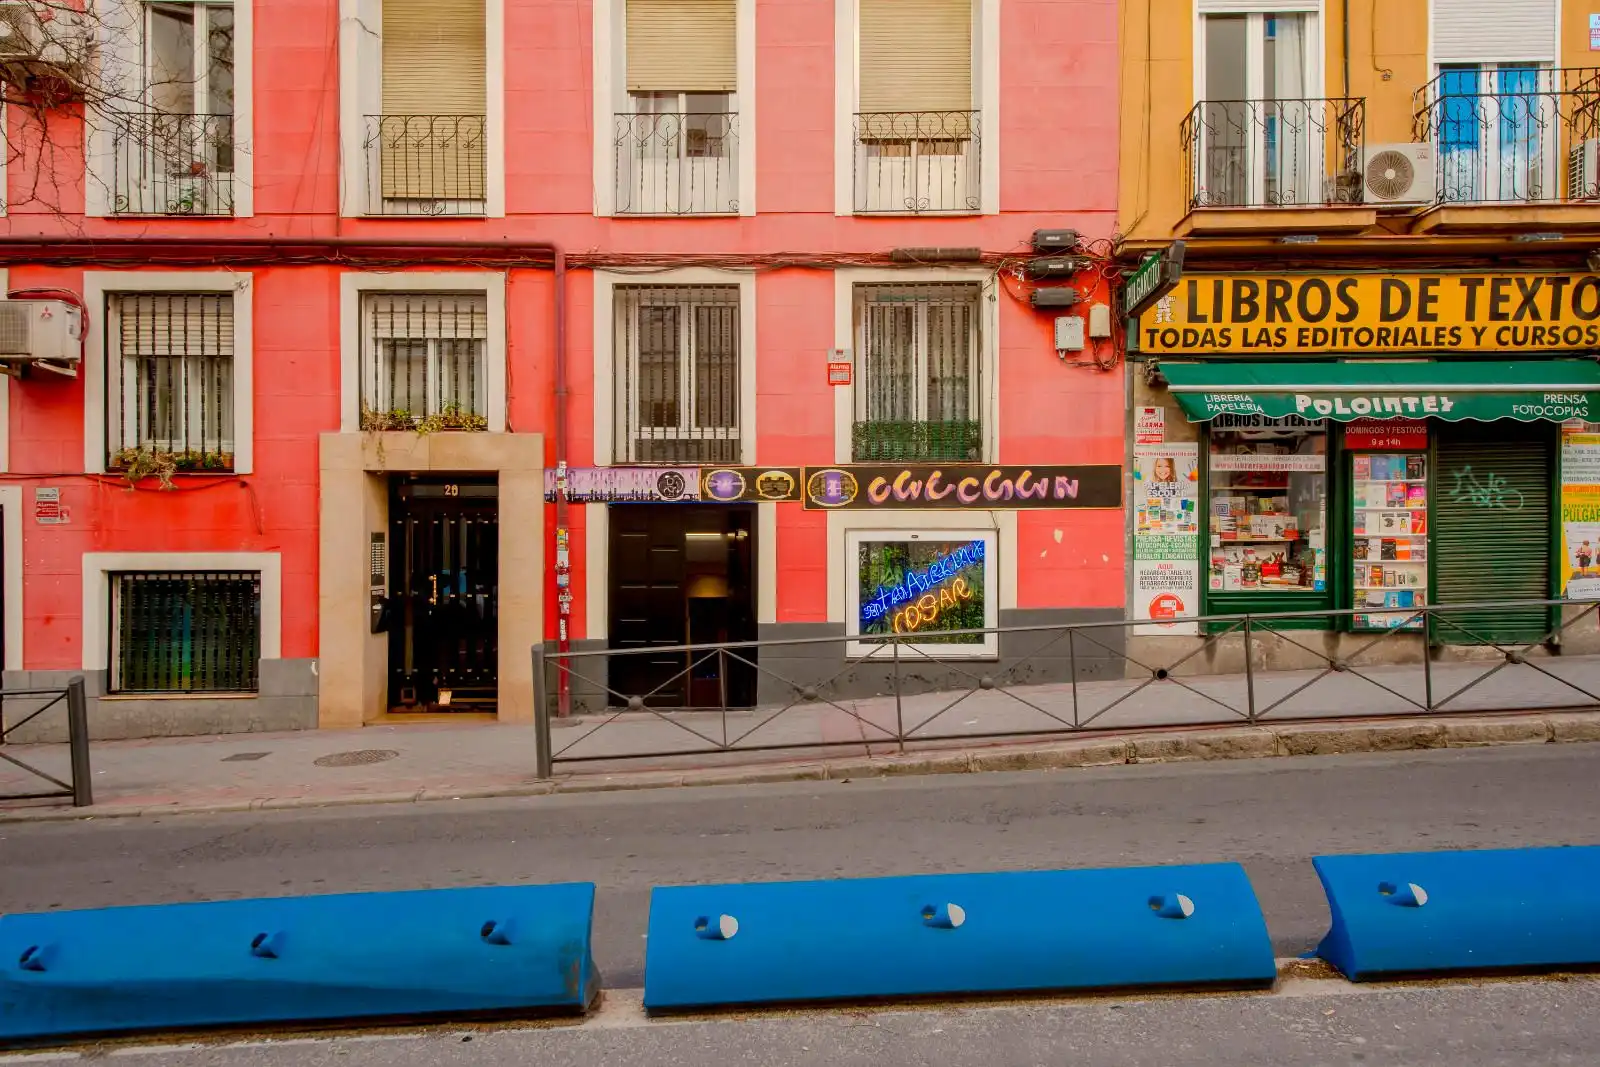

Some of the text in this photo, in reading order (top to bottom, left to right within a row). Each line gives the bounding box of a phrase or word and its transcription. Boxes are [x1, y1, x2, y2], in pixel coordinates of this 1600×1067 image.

[1186, 275, 1600, 324] LIBROS DE TEXTO
[1145, 325, 1599, 349] TODAS LAS EDITORIALES Y CURSOS
[1204, 394, 1253, 403] LIBRERIA
[1543, 394, 1588, 404] PRENSA
[1207, 402, 1265, 413] PAPELERIA
[1512, 405, 1589, 417] FOTOCOPIAS
[1345, 426, 1427, 434] DOMINGOS Y FESTIVOS
[1371, 438, 1377, 446] 9
[1385, 438, 1401, 446] 14h
